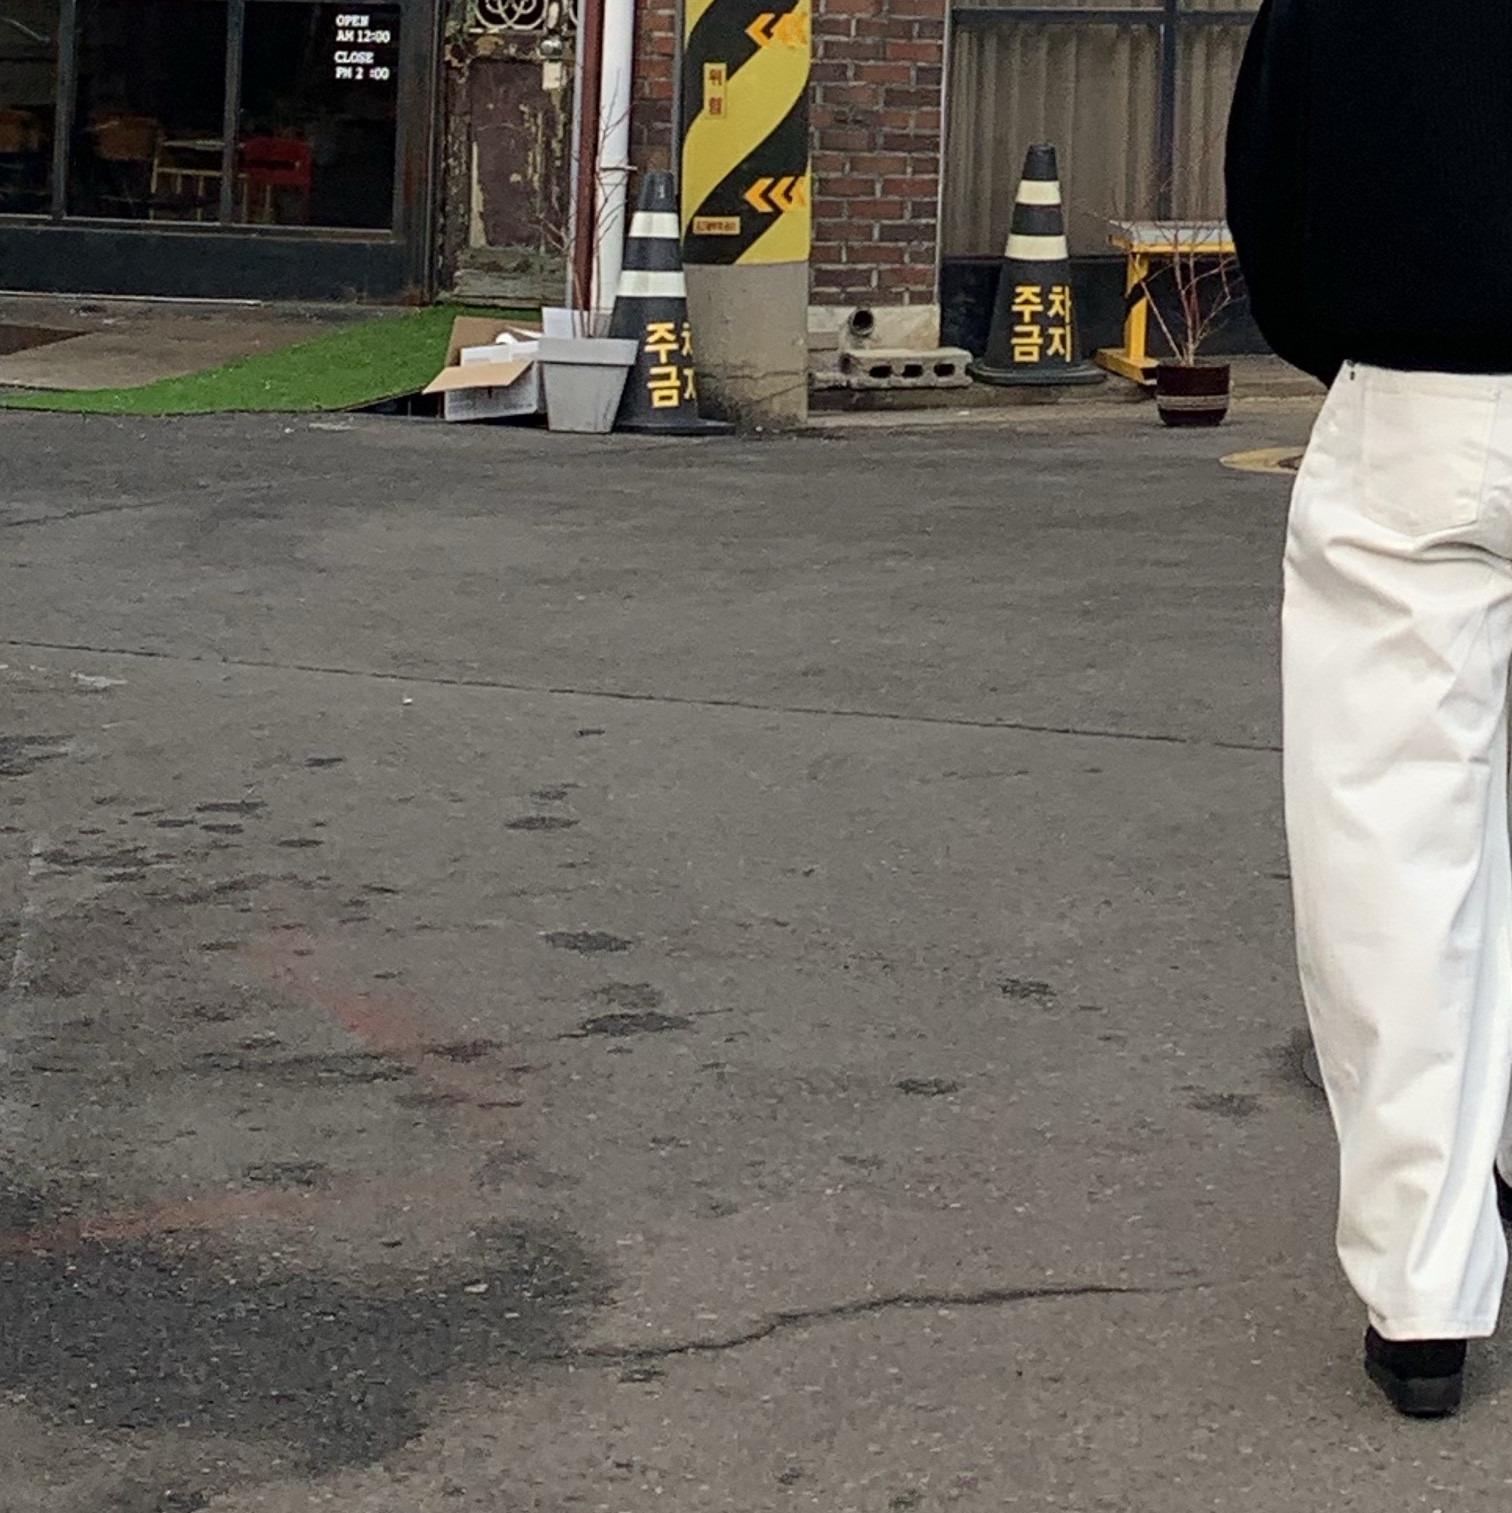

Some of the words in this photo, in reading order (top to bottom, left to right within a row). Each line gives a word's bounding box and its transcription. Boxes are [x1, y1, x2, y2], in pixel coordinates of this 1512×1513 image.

[335, 13, 370, 28] OPEN
[335, 29, 355, 43] AM
[356, 29, 391, 44] 12:00
[334, 50, 375, 65] CLOSE
[335, 66, 353, 80] PM
[1011, 285, 1072, 323] 주차
[1010, 324, 1072, 362] 금지
